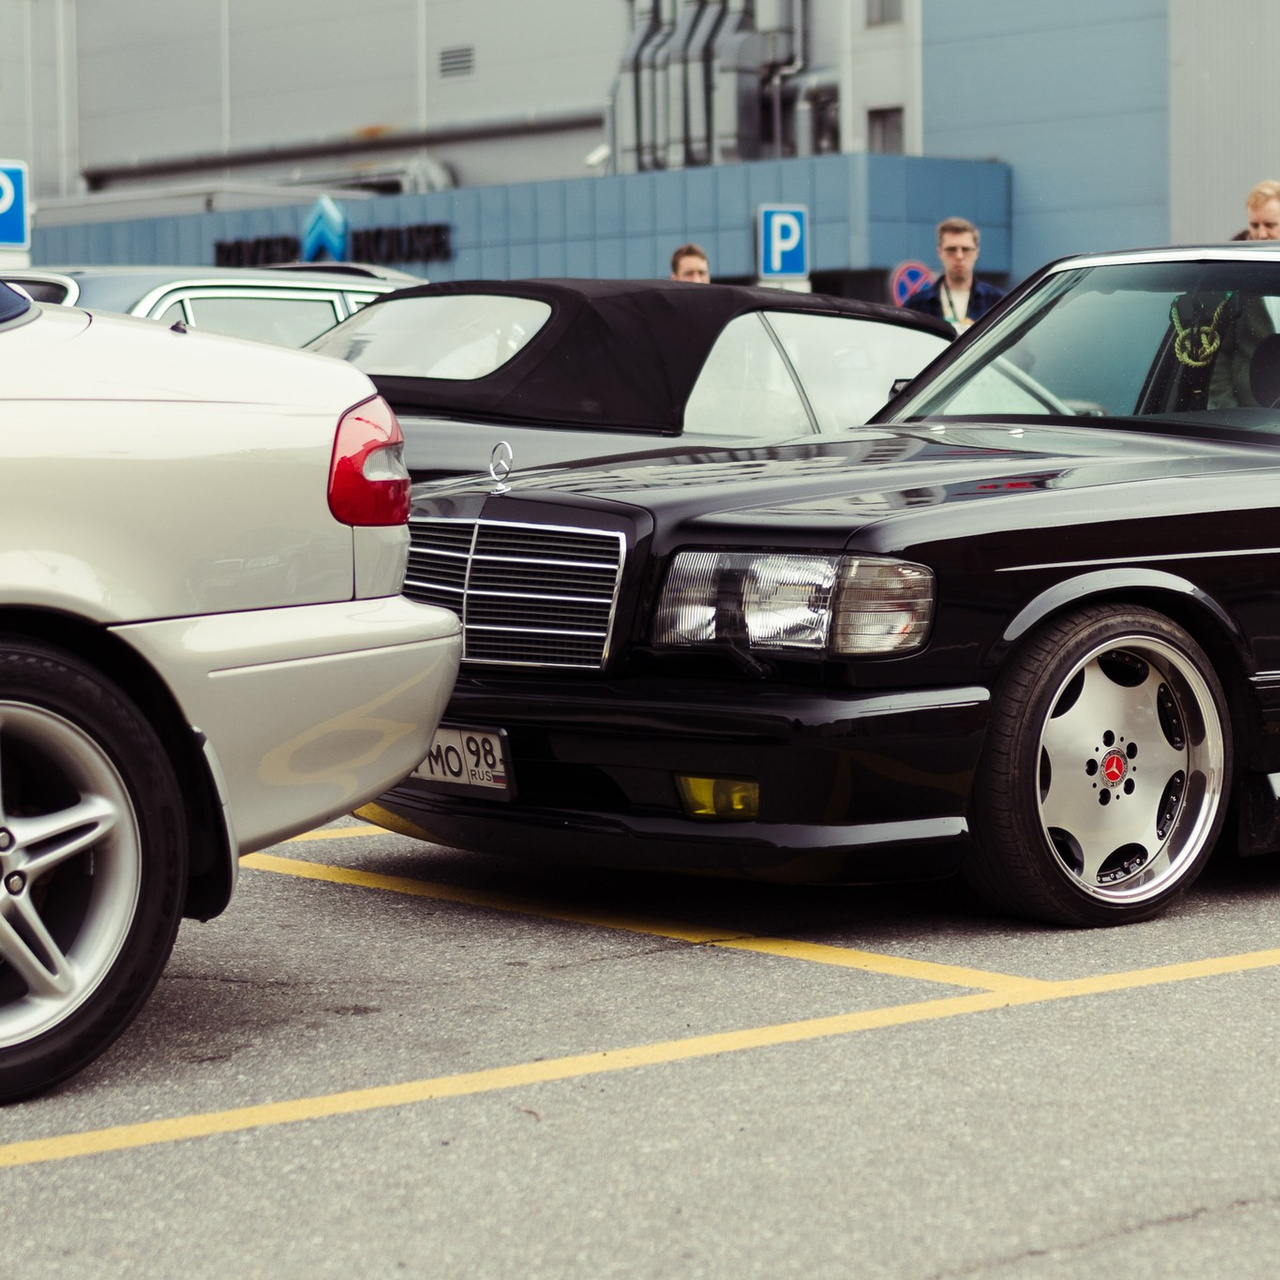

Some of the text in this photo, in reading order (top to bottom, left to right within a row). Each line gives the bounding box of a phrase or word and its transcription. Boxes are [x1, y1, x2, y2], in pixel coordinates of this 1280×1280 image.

[771, 213, 801, 272] P
[414, 735, 497, 778] MO 98
[470, 769, 492, 782] RUS
